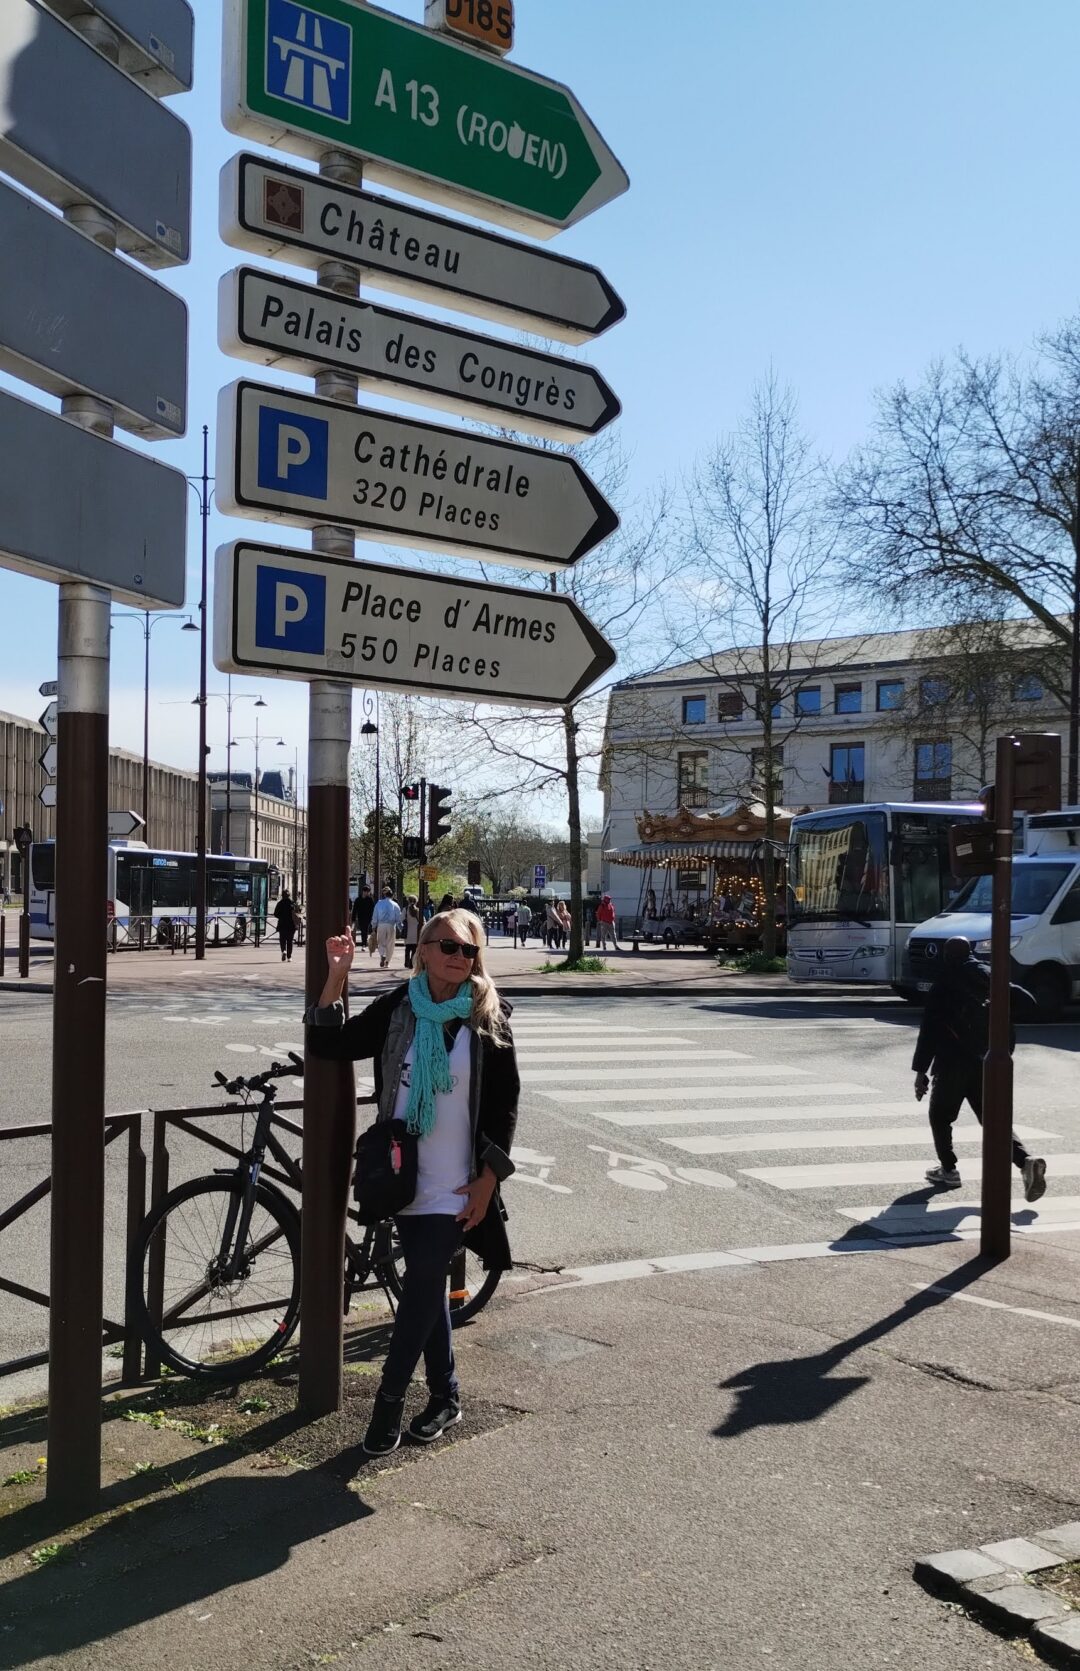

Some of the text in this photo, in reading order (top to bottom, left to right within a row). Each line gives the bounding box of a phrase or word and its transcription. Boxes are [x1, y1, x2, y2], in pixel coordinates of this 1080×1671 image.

[320, 202, 460, 274] Château
[260, 295, 575, 410] Palais des Congrès
[277, 423, 311, 479] P
[354, 431, 530, 498] Cathédrale
[353, 478, 500, 531] 320 Places
[275, 582, 308, 636] P
[341, 581, 421, 623] Place
[340, 632, 500, 678] 550 Places
